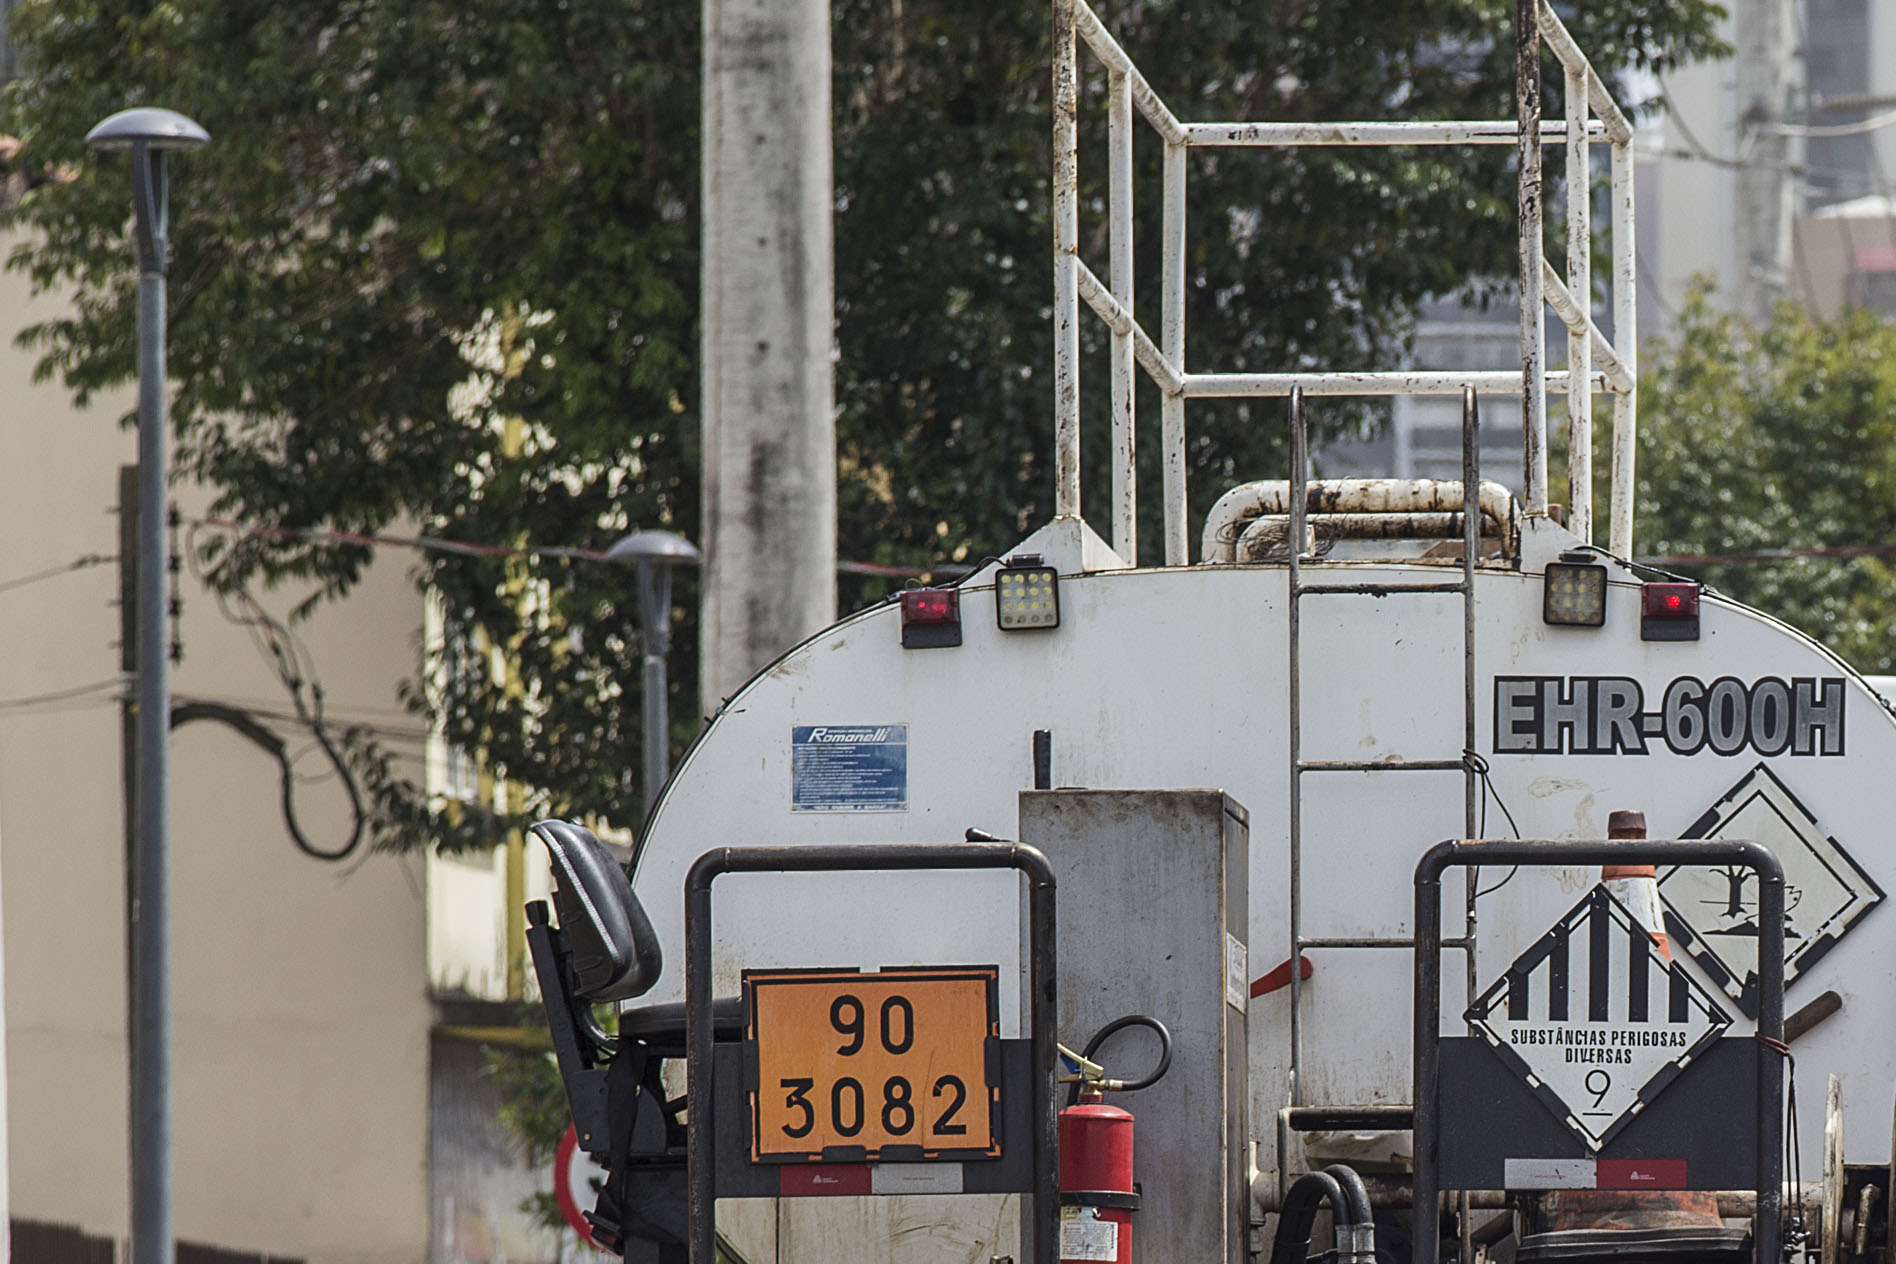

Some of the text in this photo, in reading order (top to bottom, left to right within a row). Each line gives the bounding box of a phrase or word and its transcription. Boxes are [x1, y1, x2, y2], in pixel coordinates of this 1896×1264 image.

[807, 727, 893, 743] Romanelli
[1493, 675, 1847, 757] EHR-600H
[830, 994, 914, 1057] 90
[1510, 1027, 1687, 1048] SUBSTÂNCIAS PERIGOSAS
[1565, 1048, 1632, 1064] DIVERSAS
[780, 1075, 967, 1139] 3082
[1584, 1069, 1611, 1109] 9
